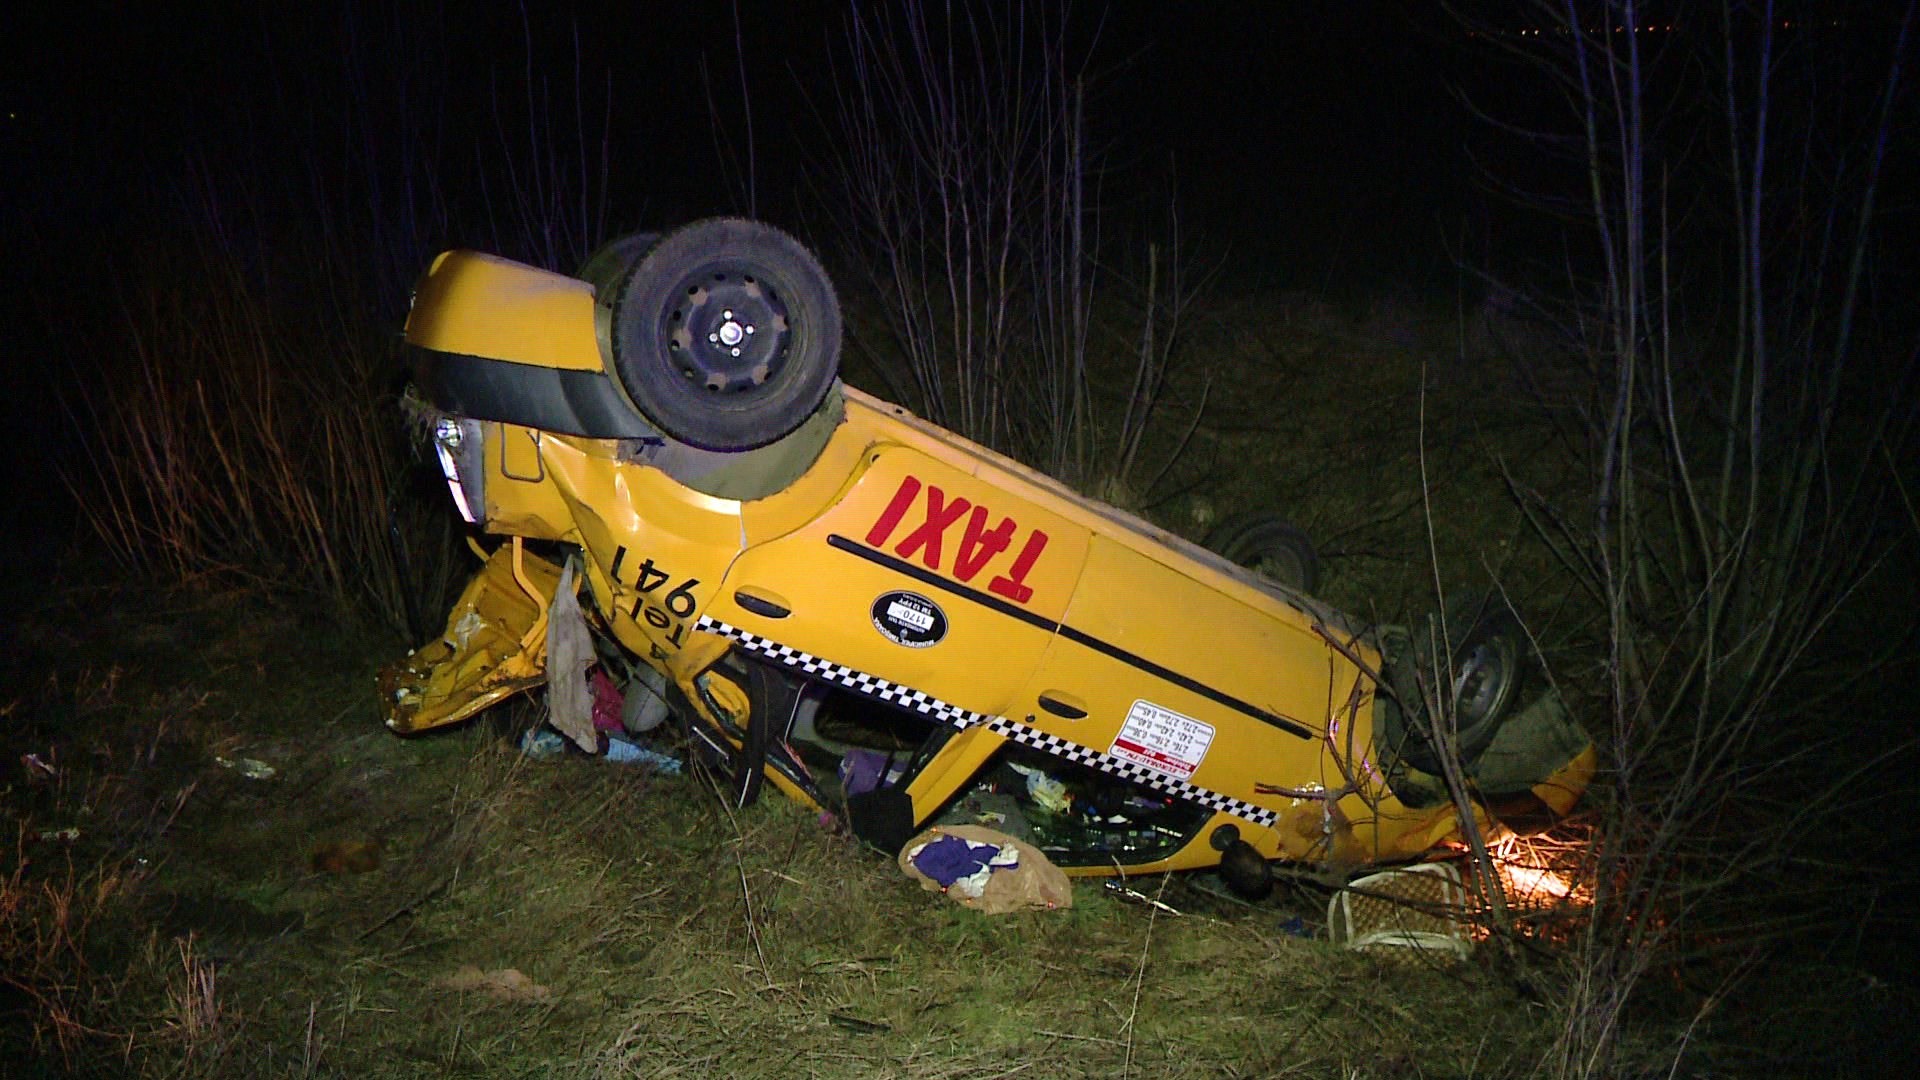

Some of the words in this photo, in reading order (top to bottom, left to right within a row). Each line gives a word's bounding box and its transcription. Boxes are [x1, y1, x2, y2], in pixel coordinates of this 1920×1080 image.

[865, 475, 1049, 604] TAXI
[610, 545, 700, 618] 941
[903, 610, 926, 625] 1170
[921, 607, 932, 615] TM
